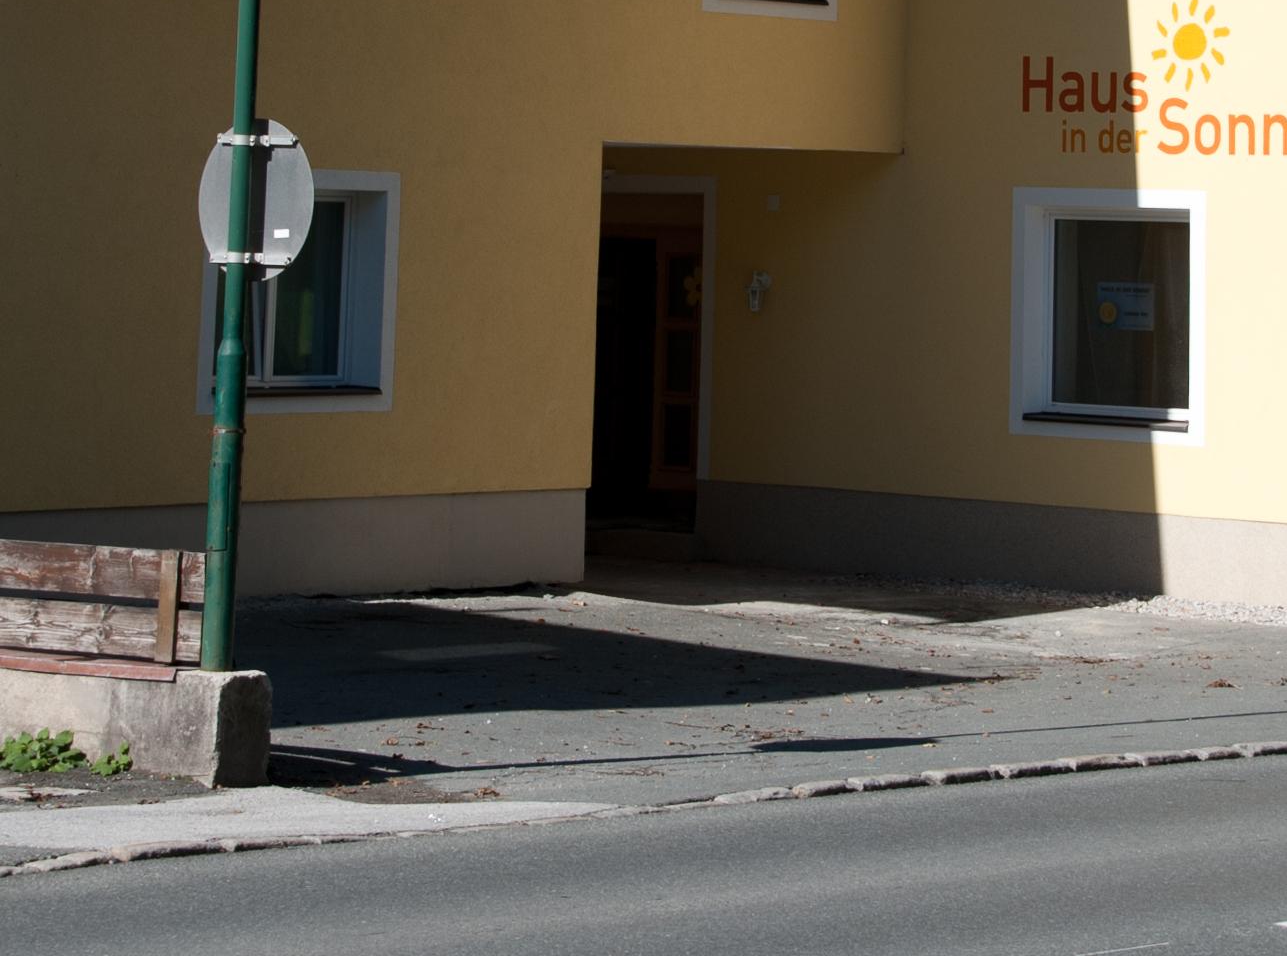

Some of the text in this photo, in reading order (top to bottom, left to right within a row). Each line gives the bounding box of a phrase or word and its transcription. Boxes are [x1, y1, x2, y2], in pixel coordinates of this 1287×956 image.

[1021, 55, 1149, 113] Haus
[1060, 120, 1086, 153] in
[1097, 119, 1149, 154] der
